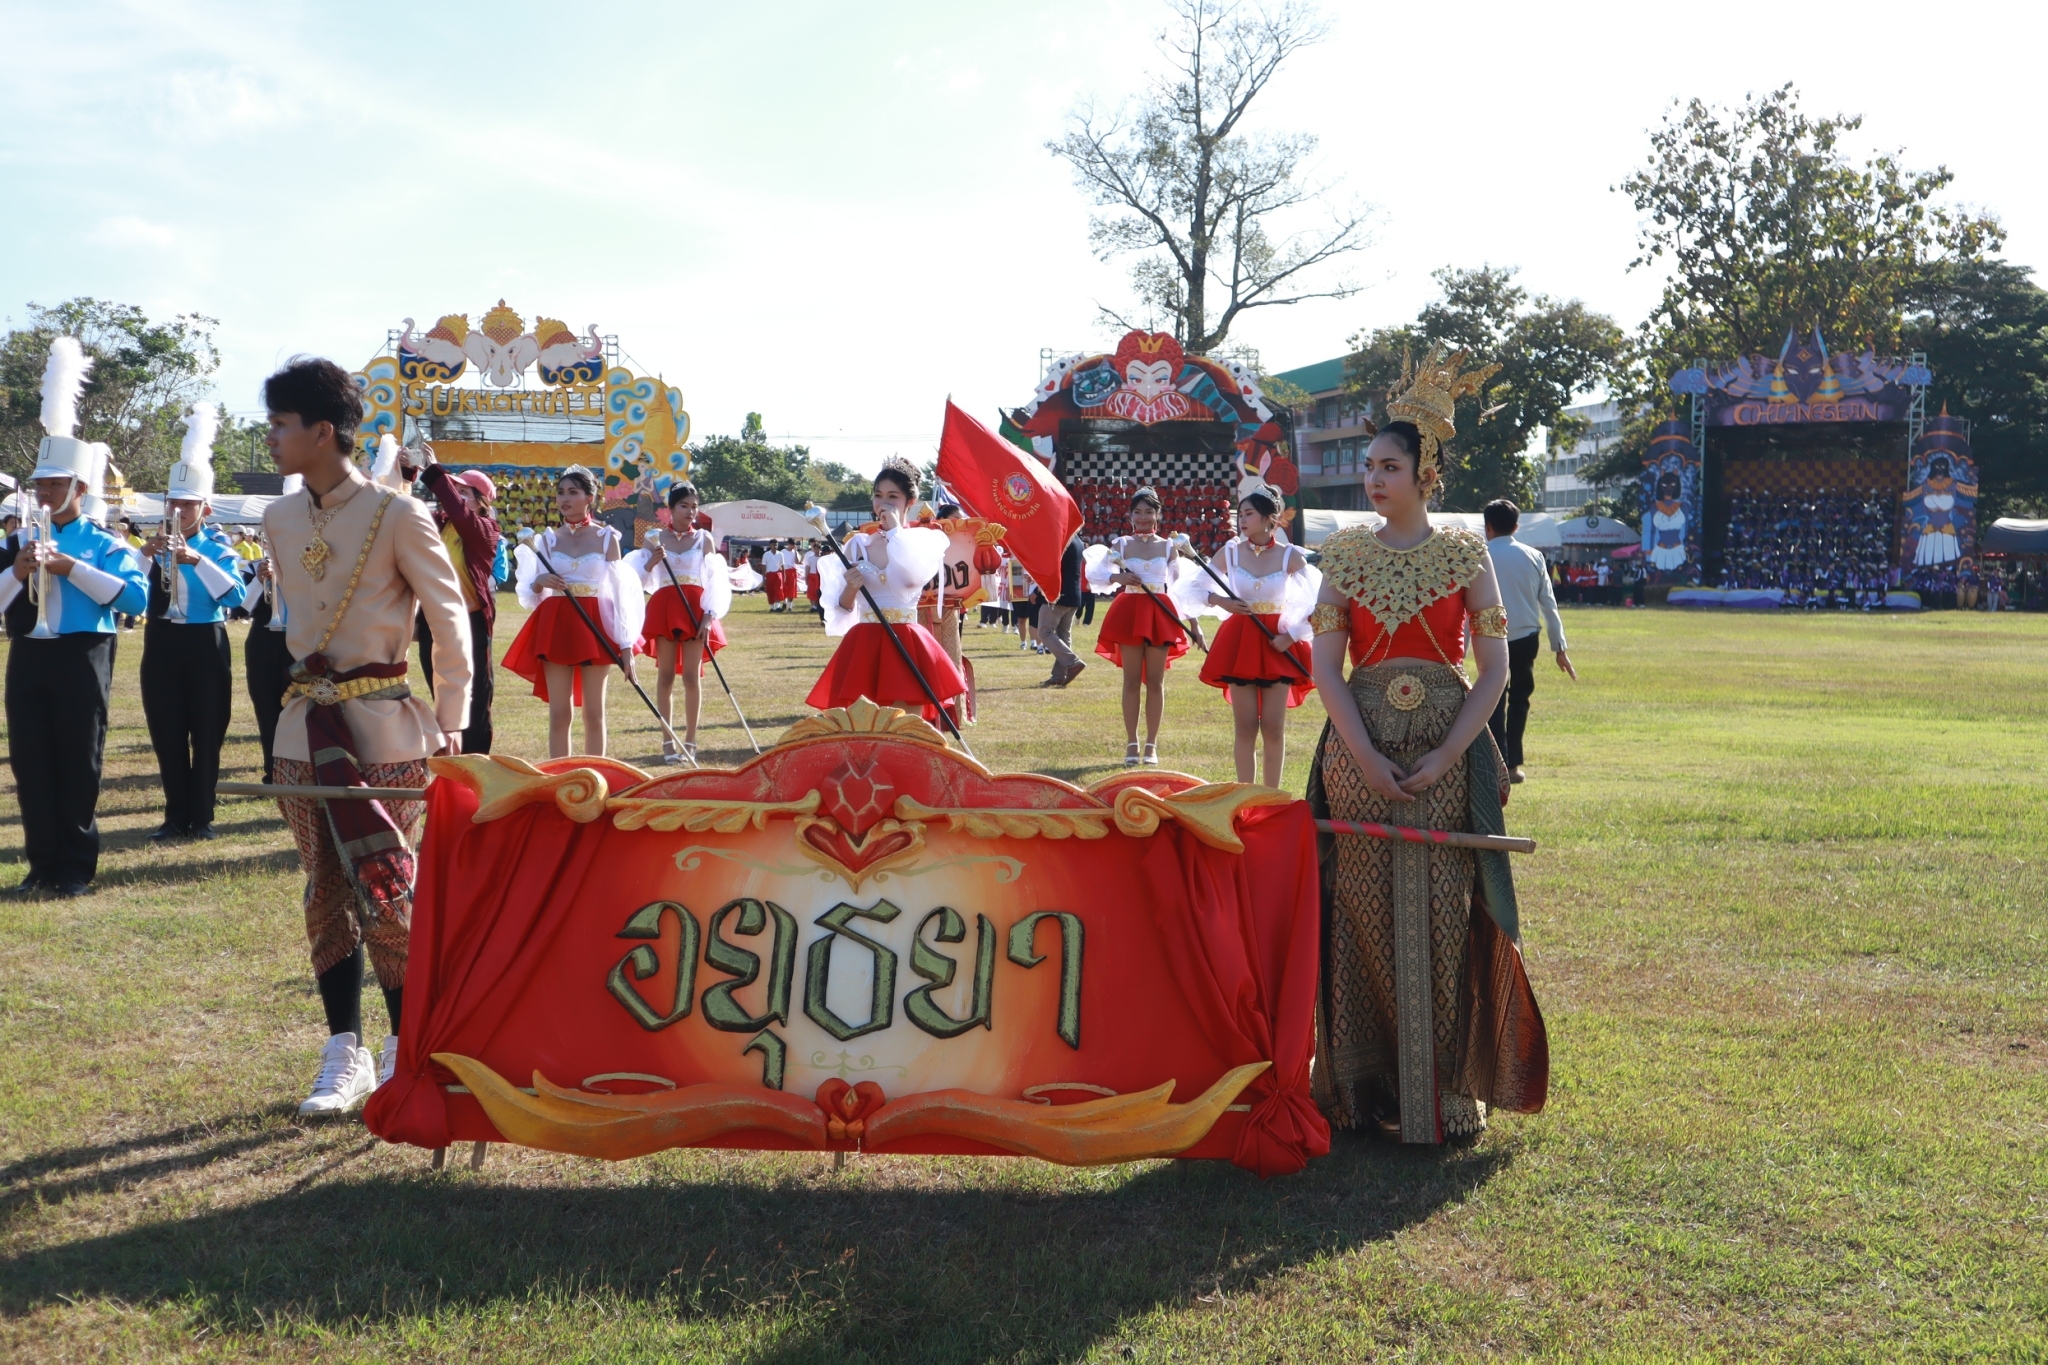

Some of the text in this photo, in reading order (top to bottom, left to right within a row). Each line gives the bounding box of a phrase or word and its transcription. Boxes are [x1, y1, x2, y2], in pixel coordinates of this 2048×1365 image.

[404, 382, 602, 417] SUKHOTHAI
[1734, 402, 1878, 426] CHIANGSEAN
[606, 896, 1085, 1090] อยุธยา
